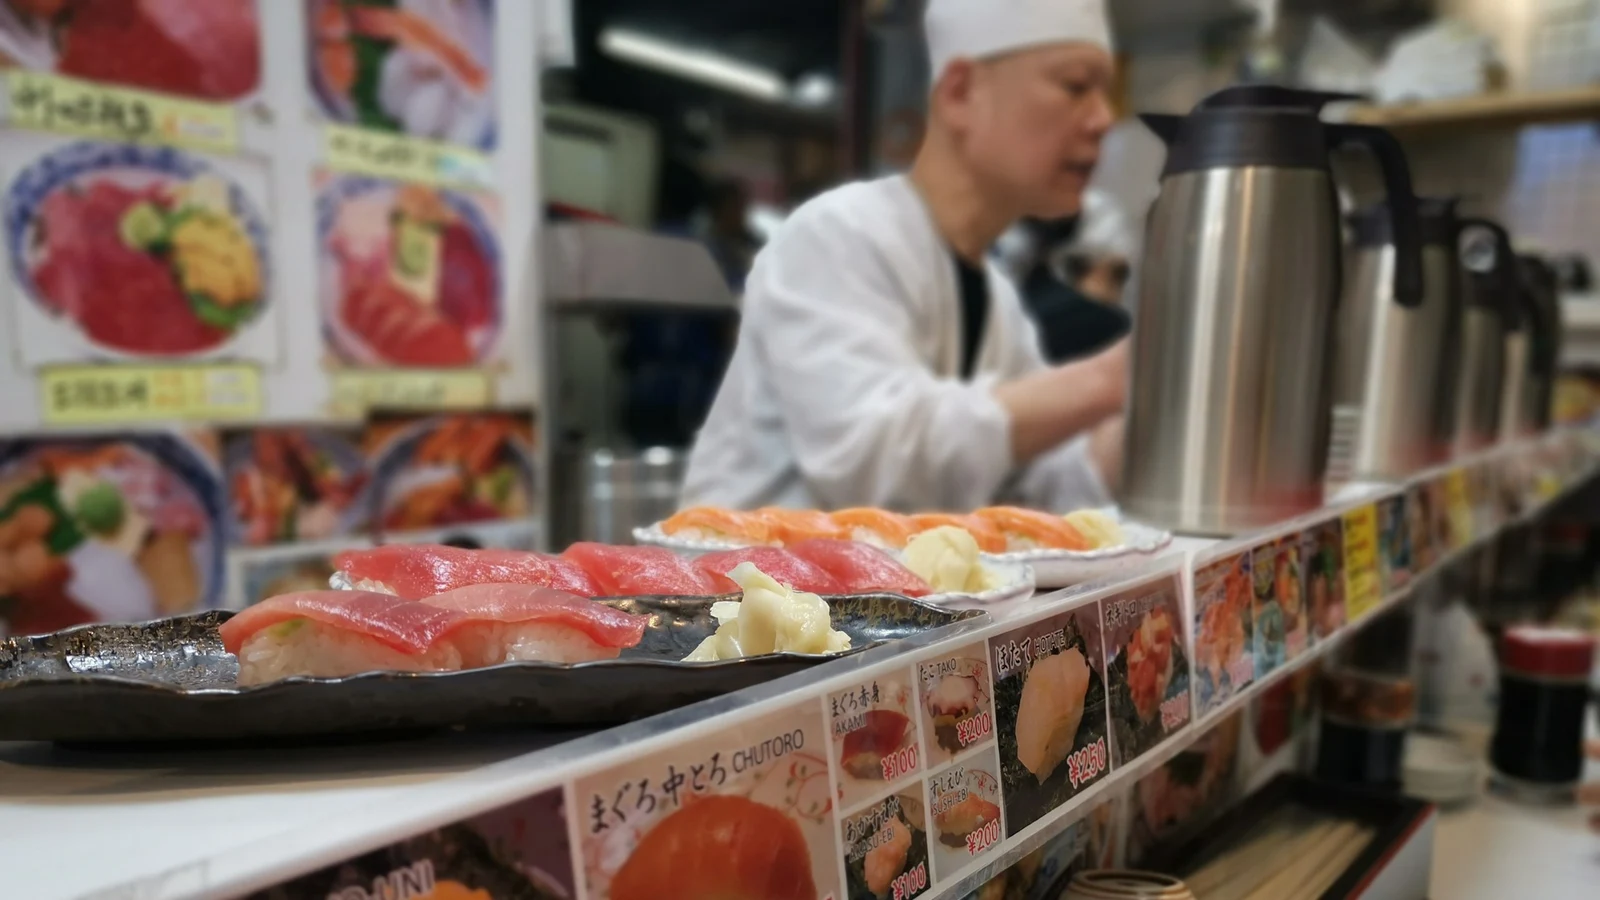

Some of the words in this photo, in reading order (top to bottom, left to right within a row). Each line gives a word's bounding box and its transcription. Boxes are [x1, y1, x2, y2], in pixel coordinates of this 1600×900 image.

[919, 663, 934, 682] たこ
[936, 657, 957, 675] TAKO
[995, 637, 1032, 675] ほたて
[1034, 628, 1066, 659] HOTATE
[831, 681, 880, 717] まぐろ赤身
[835, 713, 867, 736] AKAMI
[956, 712, 991, 747] ¥200
[881, 746, 917, 783] ¥100
[1067, 736, 1107, 789] ¥250
[591, 752, 727, 833] まぐろ中とろ
[732, 729, 804, 773] CHUTORO
[930, 767, 964, 798] すしえび
[933, 787, 970, 816] SUSHI-EBI
[966, 819, 999, 856] ¥200
[891, 861, 927, 900] ¥100
